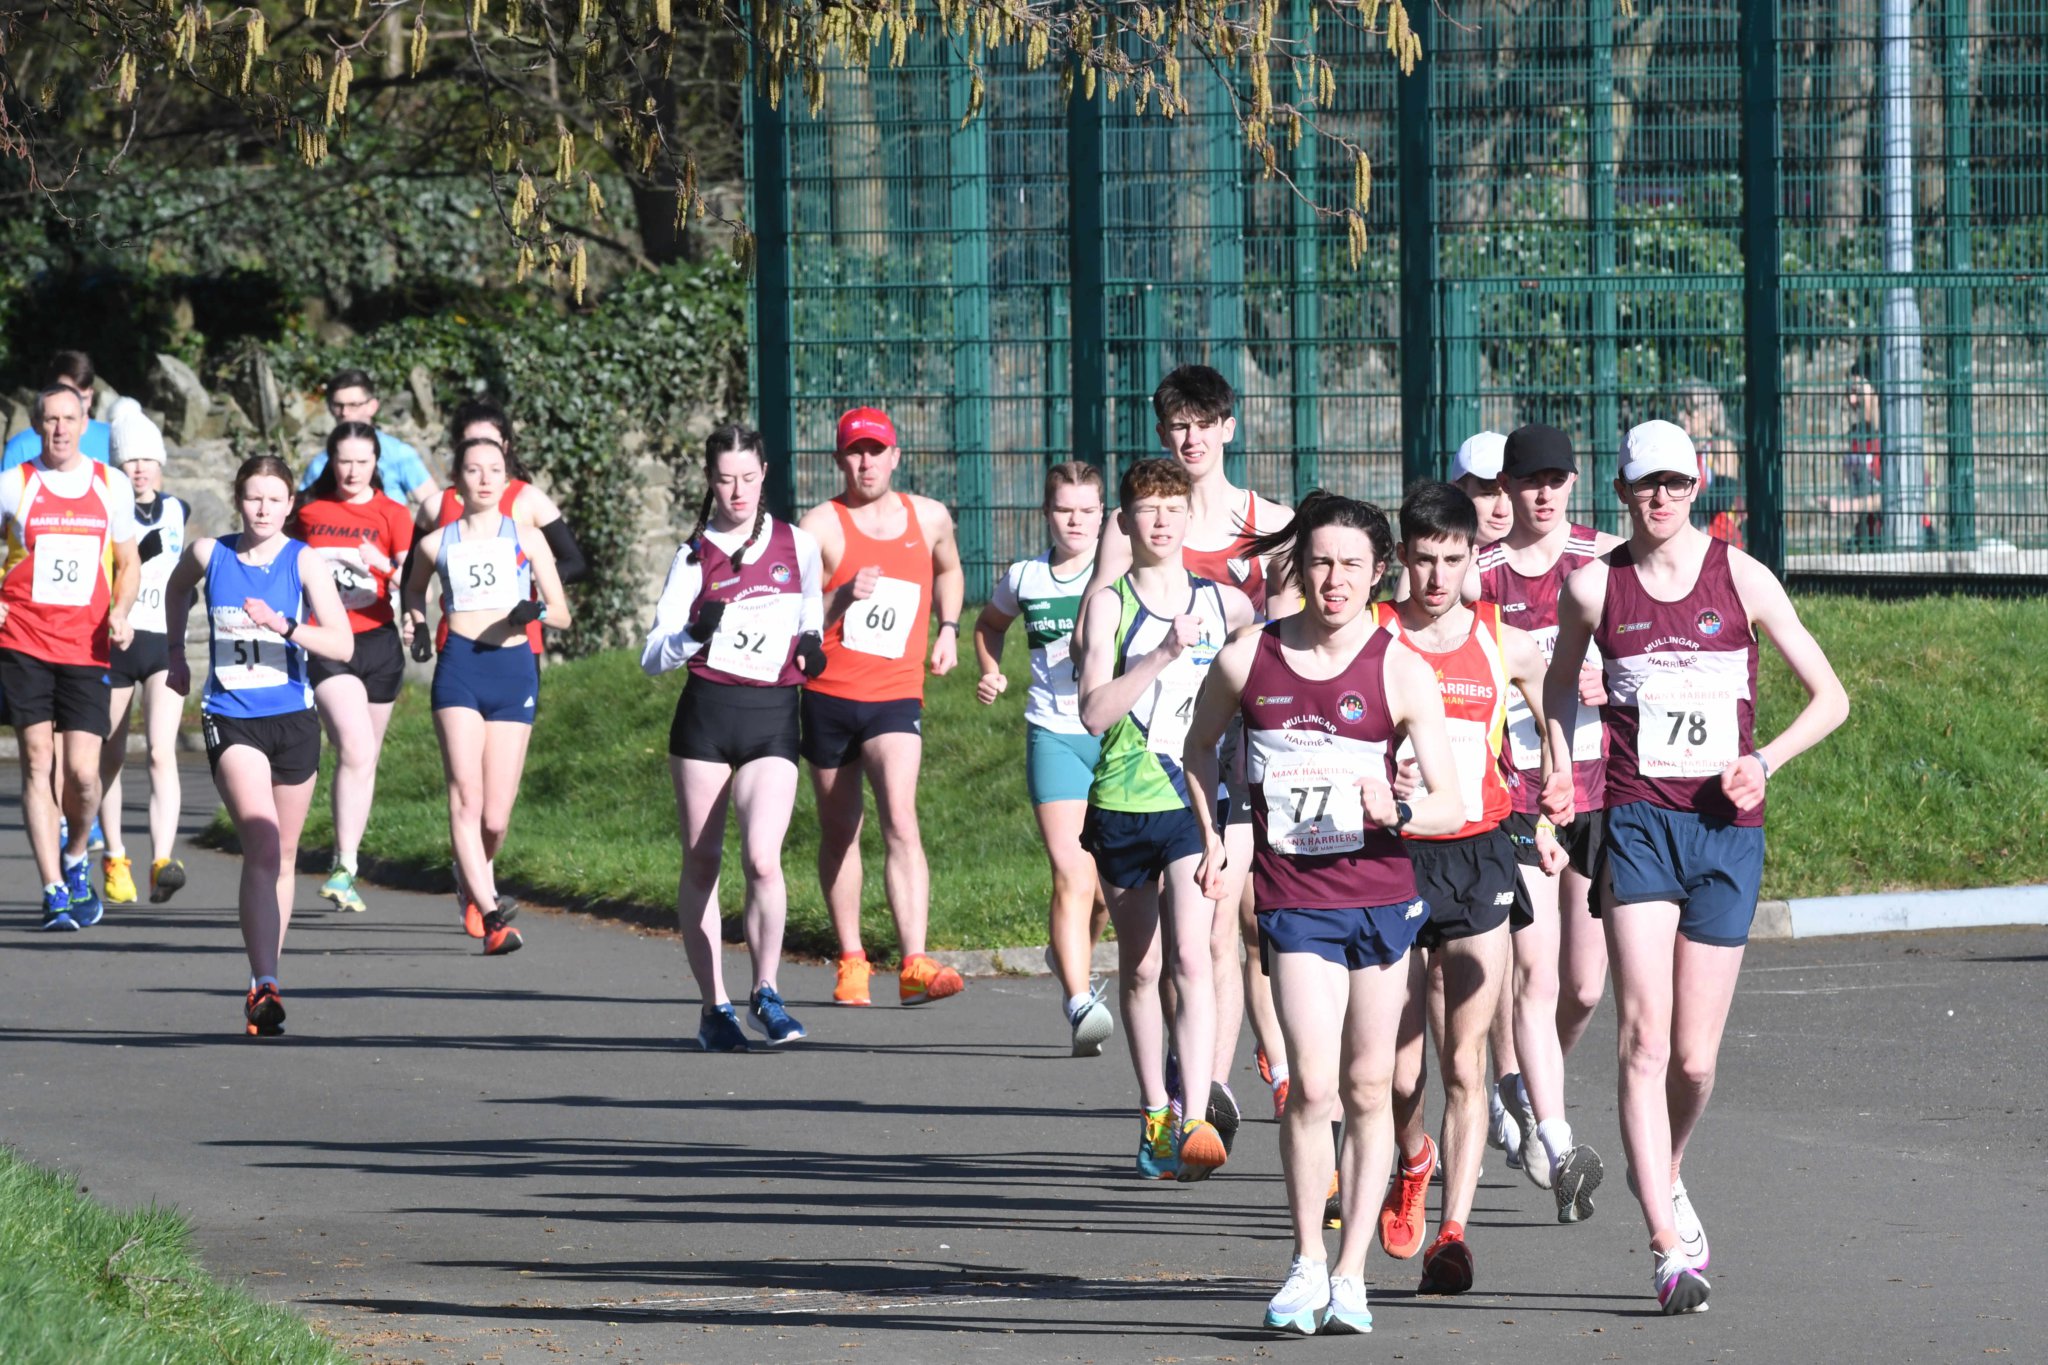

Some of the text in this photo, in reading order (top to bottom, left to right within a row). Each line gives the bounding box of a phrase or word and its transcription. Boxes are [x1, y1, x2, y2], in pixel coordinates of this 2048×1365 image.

[52, 559, 79, 583] 58
[469, 562, 496, 589] 53
[733, 585, 781, 602] MULLINGAR
[1503, 602, 1527, 613] KCS
[865, 604, 896, 632] 60
[234, 639, 260, 665] 51
[733, 630, 766, 654] 52
[1643, 635, 1701, 654] MULLINGAR
[1647, 654, 1698, 668] HARRIERS
[1439, 682, 1493, 698] ARRIERS
[1281, 714, 1338, 734] MULLINGAR
[1666, 710, 1708, 746] 78
[1271, 768, 1299, 779] MANX
[1290, 785, 1333, 823] 77
[1308, 832, 1358, 845] HARRIERS
